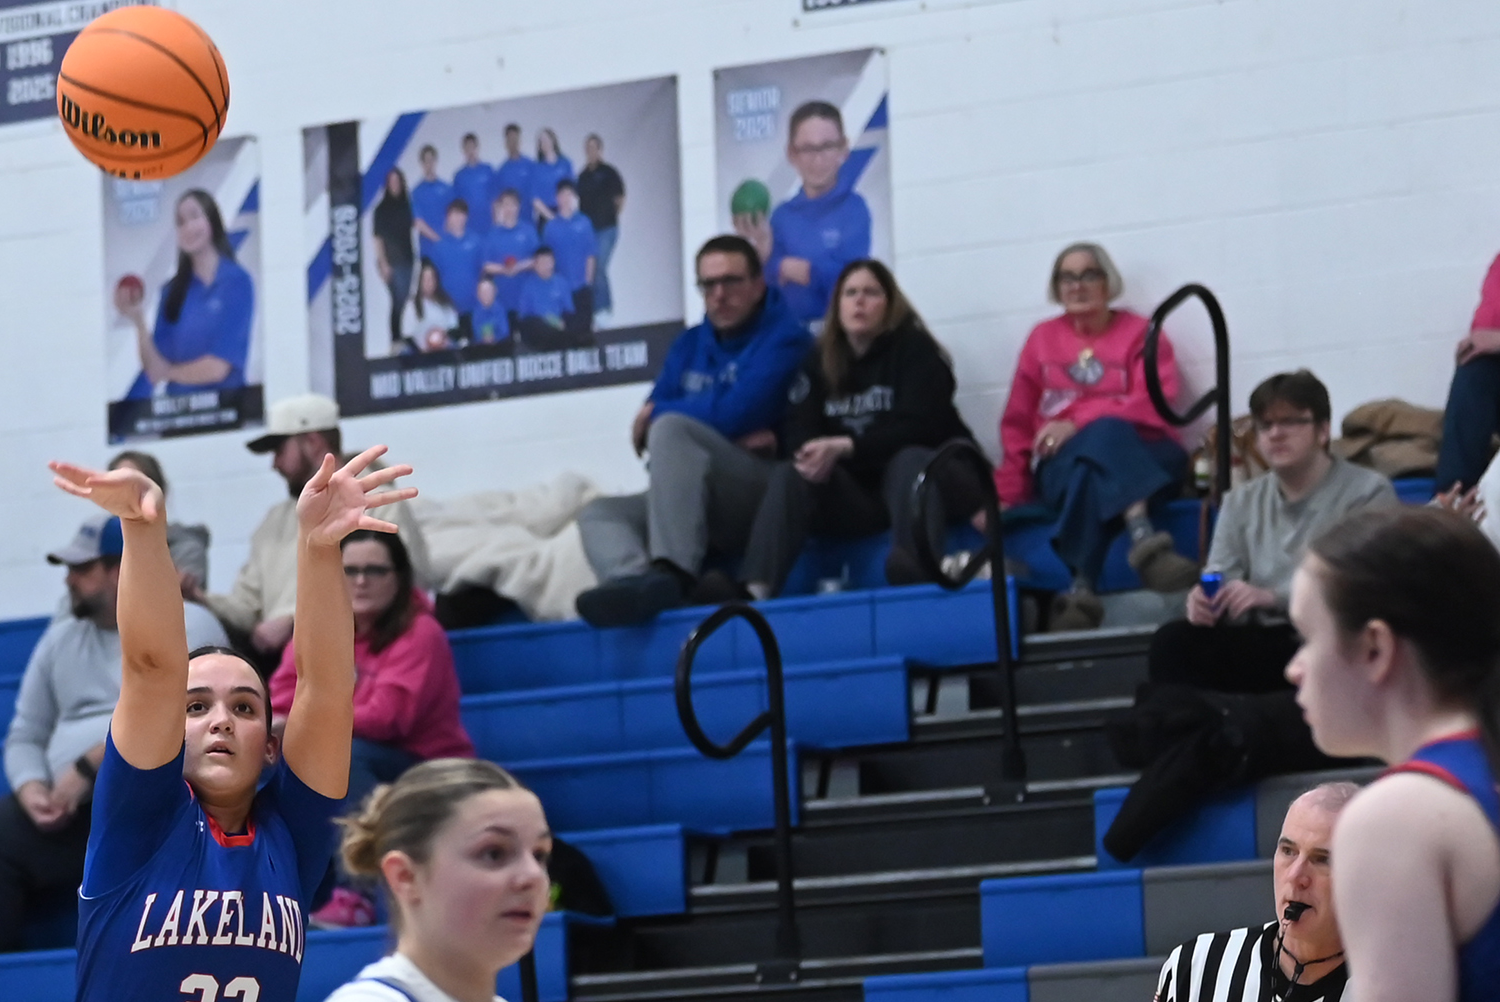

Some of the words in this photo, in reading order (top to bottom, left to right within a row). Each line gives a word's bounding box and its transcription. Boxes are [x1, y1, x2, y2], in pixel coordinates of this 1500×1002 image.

[61, 92, 161, 149] Wilson
[332, 203, 362, 336] 2025-2026
[404, 364, 455, 396] VALLEY
[604, 340, 648, 371] TEAM
